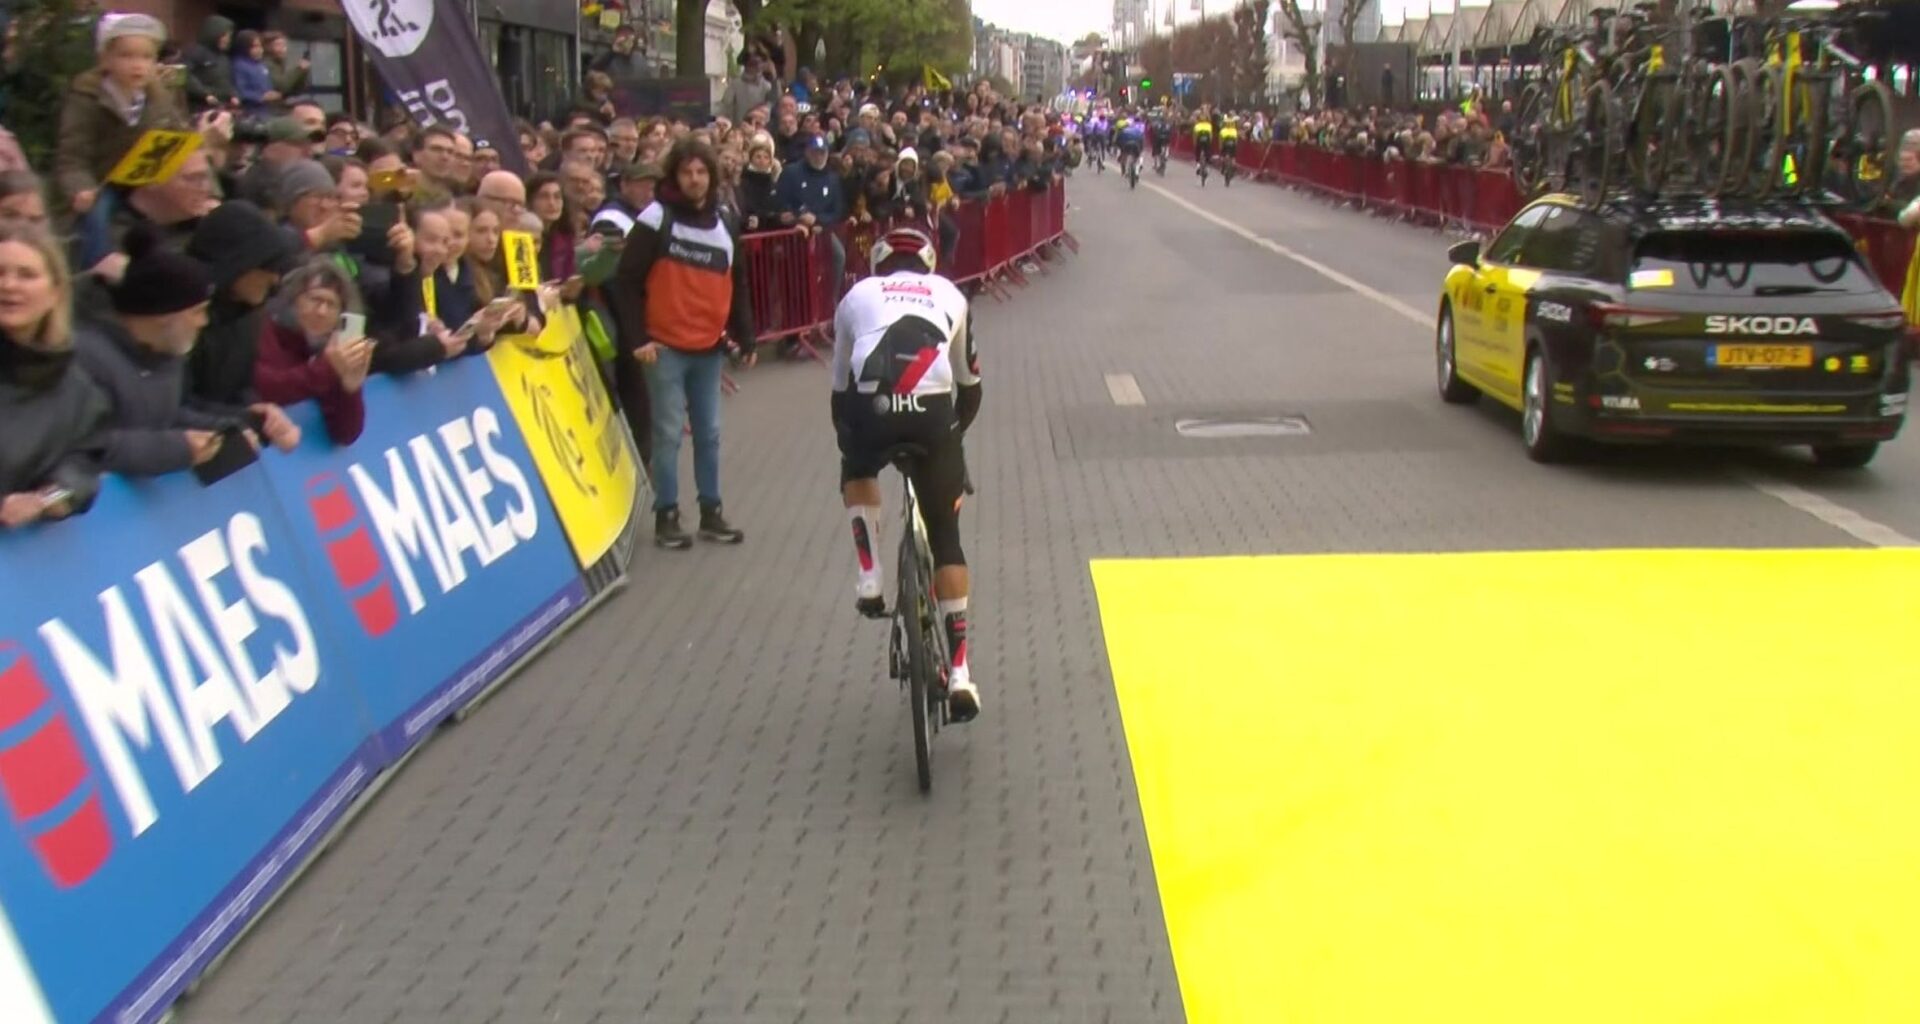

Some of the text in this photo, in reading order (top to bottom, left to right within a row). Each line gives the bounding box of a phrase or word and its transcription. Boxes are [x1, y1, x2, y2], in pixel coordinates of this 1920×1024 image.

[1705, 315, 1818, 335] SKODA
[892, 394, 926, 412] IHC
[348, 405, 538, 615] MAES
[38, 511, 319, 838] MAES
